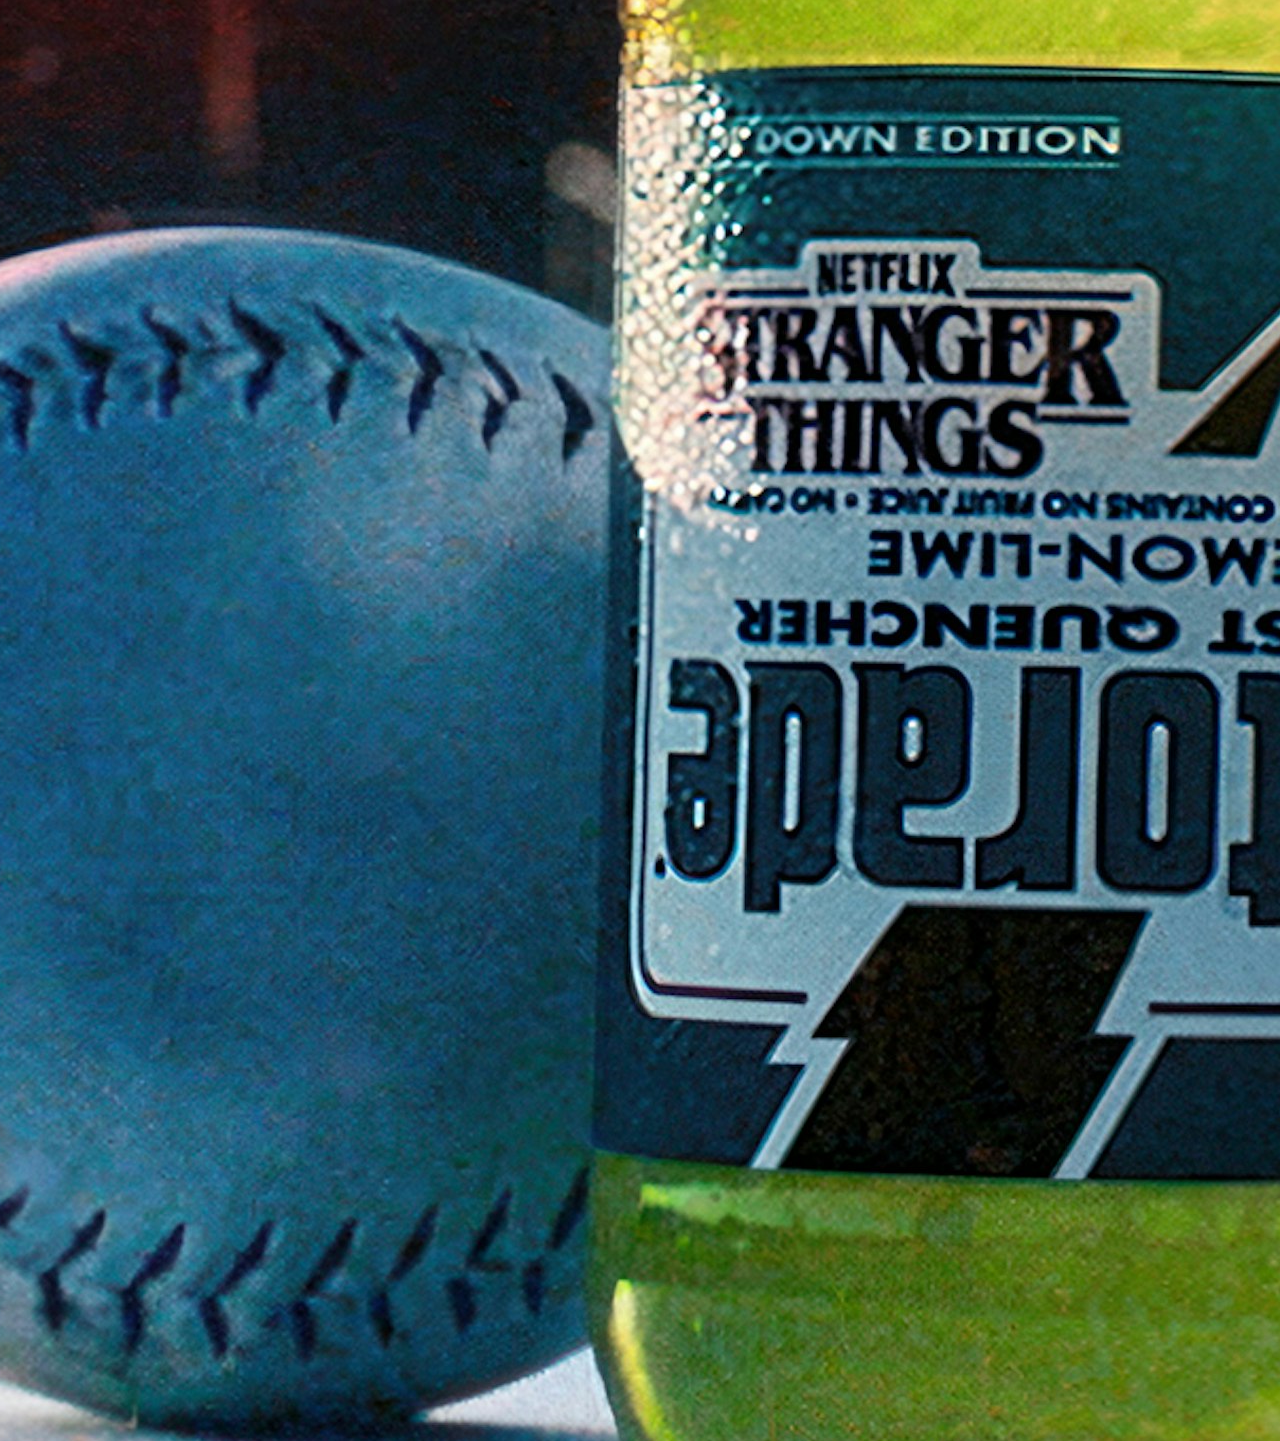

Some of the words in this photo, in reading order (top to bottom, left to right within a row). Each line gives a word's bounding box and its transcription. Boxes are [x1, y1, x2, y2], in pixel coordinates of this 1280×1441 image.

[915, 125, 1122, 156] EDITION
[816, 252, 958, 296] NETFLIX
[750, 397, 1046, 475] THINGS
[789, 485, 837, 515] NO
[868, 485, 950, 517] JUICE
[953, 487, 1036, 519] FRUIT
[1042, 489, 1099, 520] NO
[1104, 491, 1276, 521] CONTAINS
[733, 598, 1181, 654] QUENCHER
